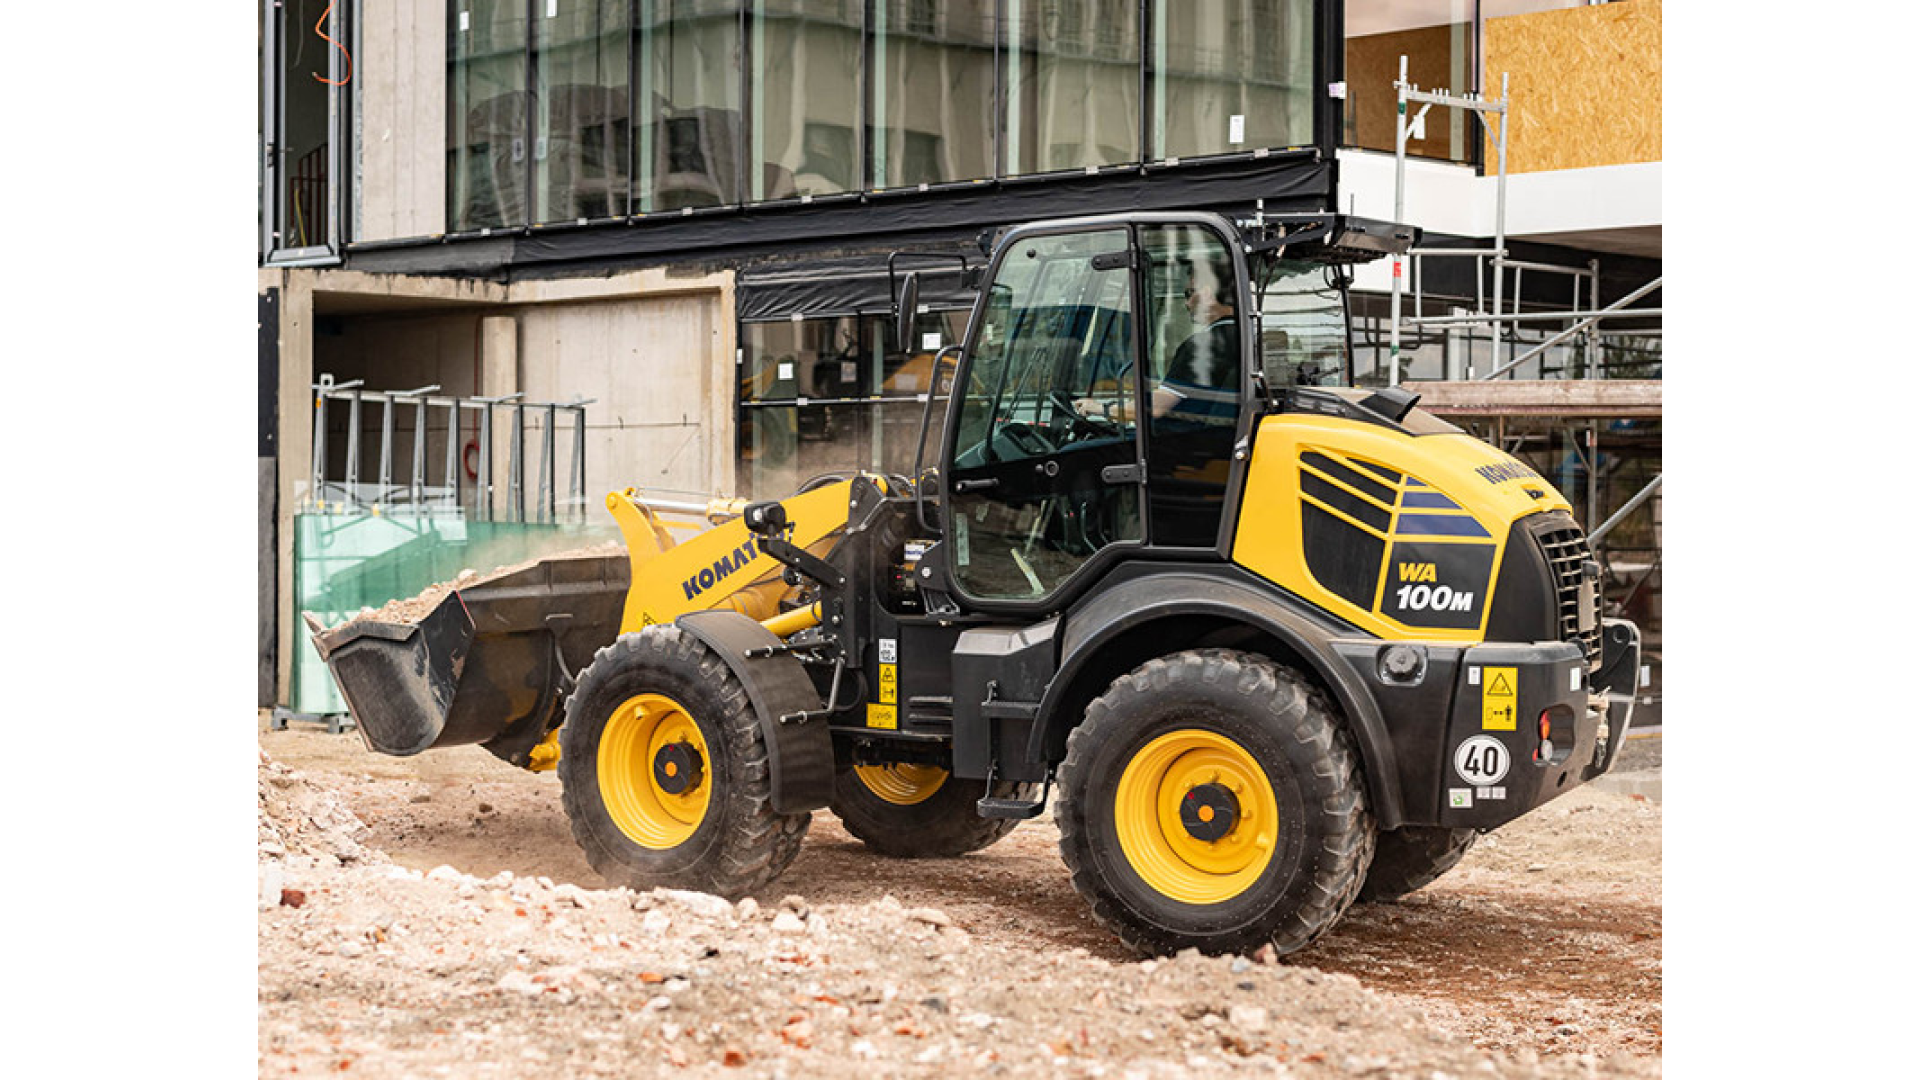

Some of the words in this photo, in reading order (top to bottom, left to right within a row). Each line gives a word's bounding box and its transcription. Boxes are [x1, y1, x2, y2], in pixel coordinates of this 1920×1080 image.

[682, 531, 785, 600] KOMAT
[1398, 562, 1437, 582] WA
[1396, 585, 1474, 611] 100M
[1464, 745, 1499, 776] 40
